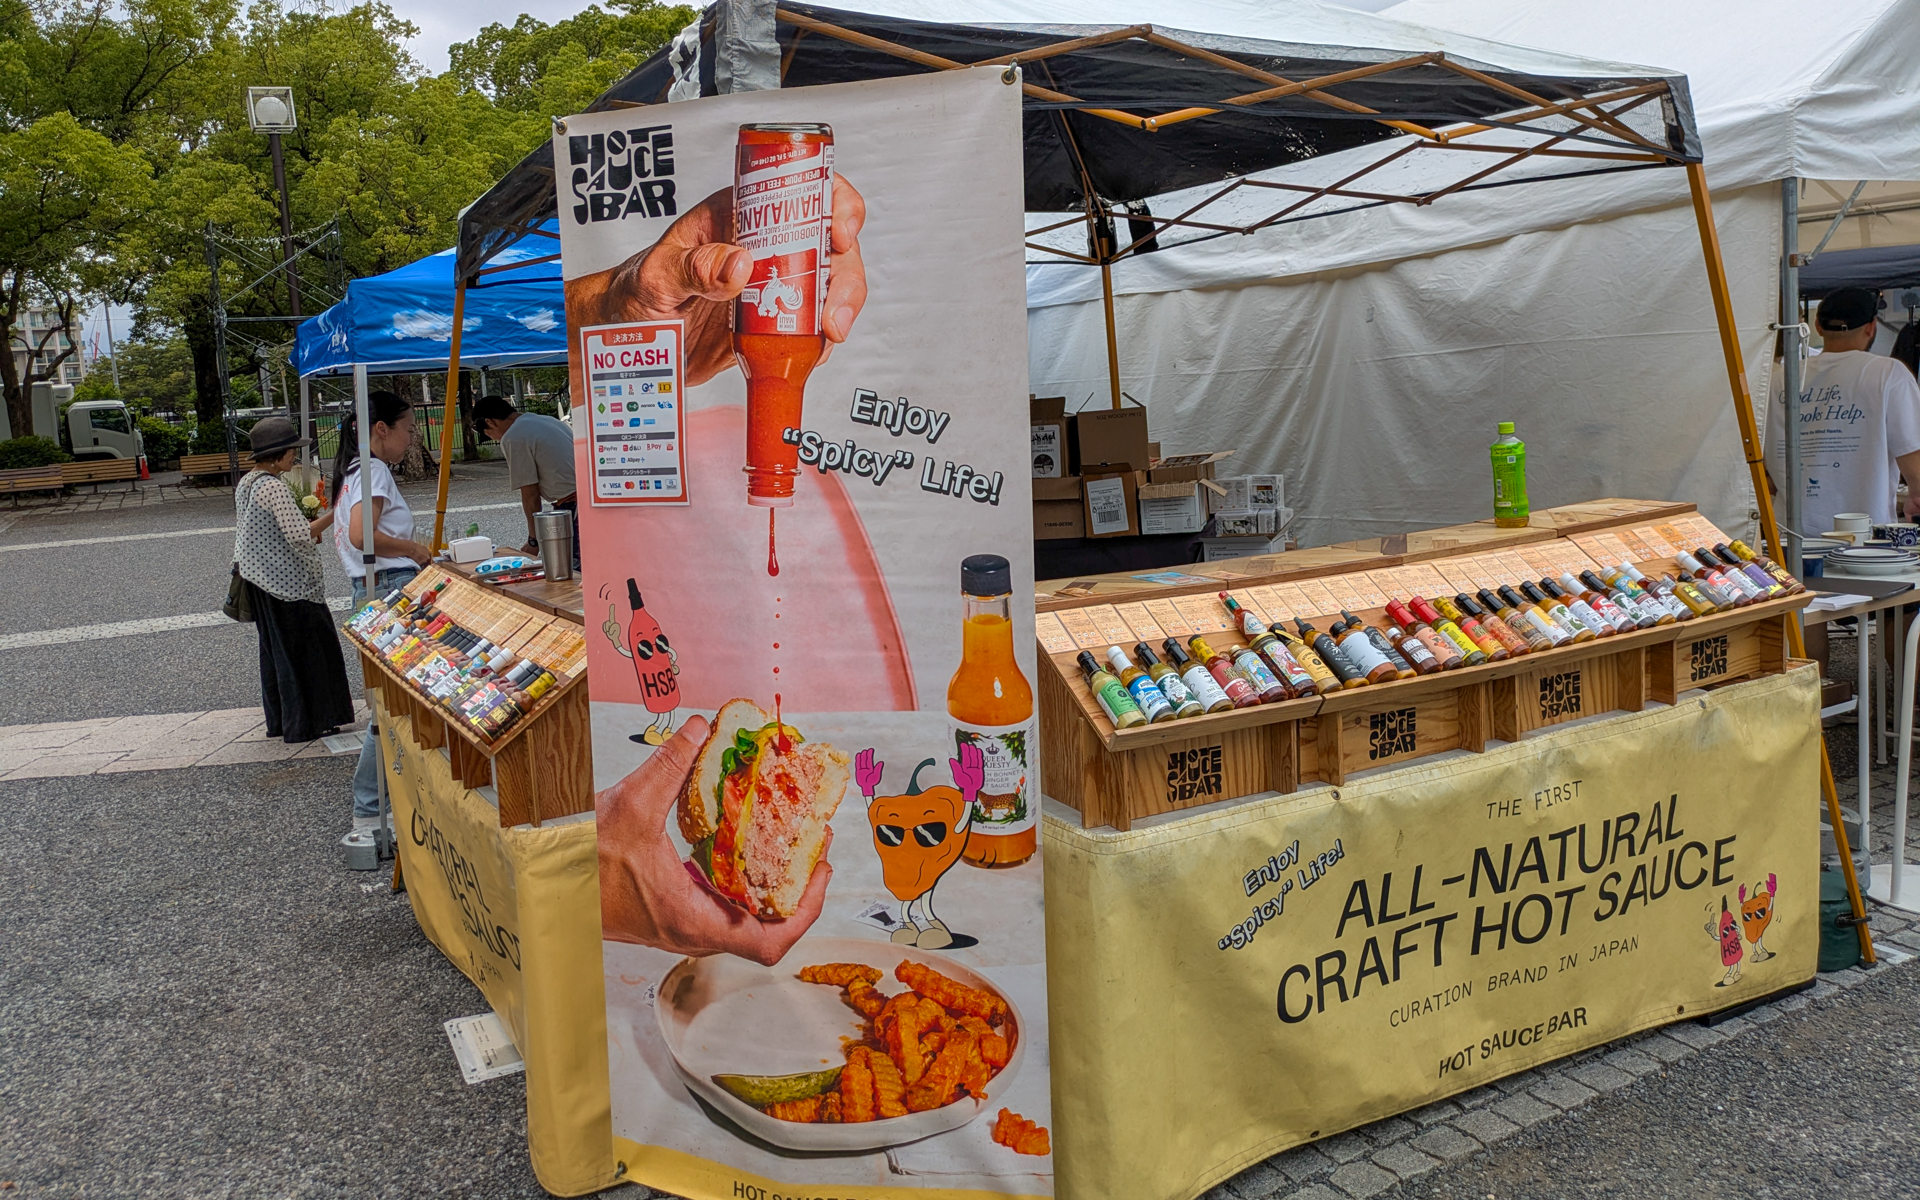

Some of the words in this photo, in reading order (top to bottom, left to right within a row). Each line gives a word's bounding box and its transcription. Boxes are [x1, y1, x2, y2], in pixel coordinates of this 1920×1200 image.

[569, 125, 672, 177] HOT
[758, 182, 766, 191] IT
[766, 179, 781, 190] FEEL
[784, 174, 802, 186] POUR
[805, 169, 821, 181] OPEN
[761, 192, 783, 203] PEPPER
[803, 183, 820, 193] SMOKY
[590, 179, 677, 222] BAR
[737, 192, 821, 235] HAMAJANG
[764, 226, 780, 236] SAUCE
[779, 316, 795, 324] MAUI
[612, 332, 644, 344] 決済方法
[594, 353, 616, 370] NO
[620, 348, 669, 368] CASH
[1815, 384, 1842, 406] Life,
[851, 388, 951, 444] Enjoy
[1108, 412, 1127, 420] WOOZY
[1824, 403, 1866, 424] Help.
[603, 445, 618, 453] PayPay
[921, 457, 1004, 506] Life!
[1698, 657, 1728, 680] BAR
[641, 667, 676, 698] HSB
[1550, 695, 1581, 718] BAR
[1379, 733, 1416, 759] BAR
[993, 769, 1019, 777] BONNET
[1179, 773, 1222, 800] BAR
[1487, 799, 1522, 819] THE
[1534, 780, 1583, 810] FIRST
[1242, 839, 1300, 897] Enjoy
[1297, 838, 1345, 891] Life!
[1335, 794, 1684, 939] ALL-NATURAL
[1276, 912, 1458, 1024] CRAFT
[1471, 884, 1586, 956] HOT
[1594, 834, 1737, 922] SAUCE
[1722, 936, 1741, 959] HSB
[1389, 980, 1472, 1028] CURATION
[1487, 965, 1548, 992] BRAND
[1558, 953, 1577, 973] IN
[1589, 934, 1639, 963] JAPAN
[1438, 1044, 1475, 1078] HOT
[1480, 1023, 1544, 1060] SAUCE
[1547, 1007, 1588, 1036] BAR
